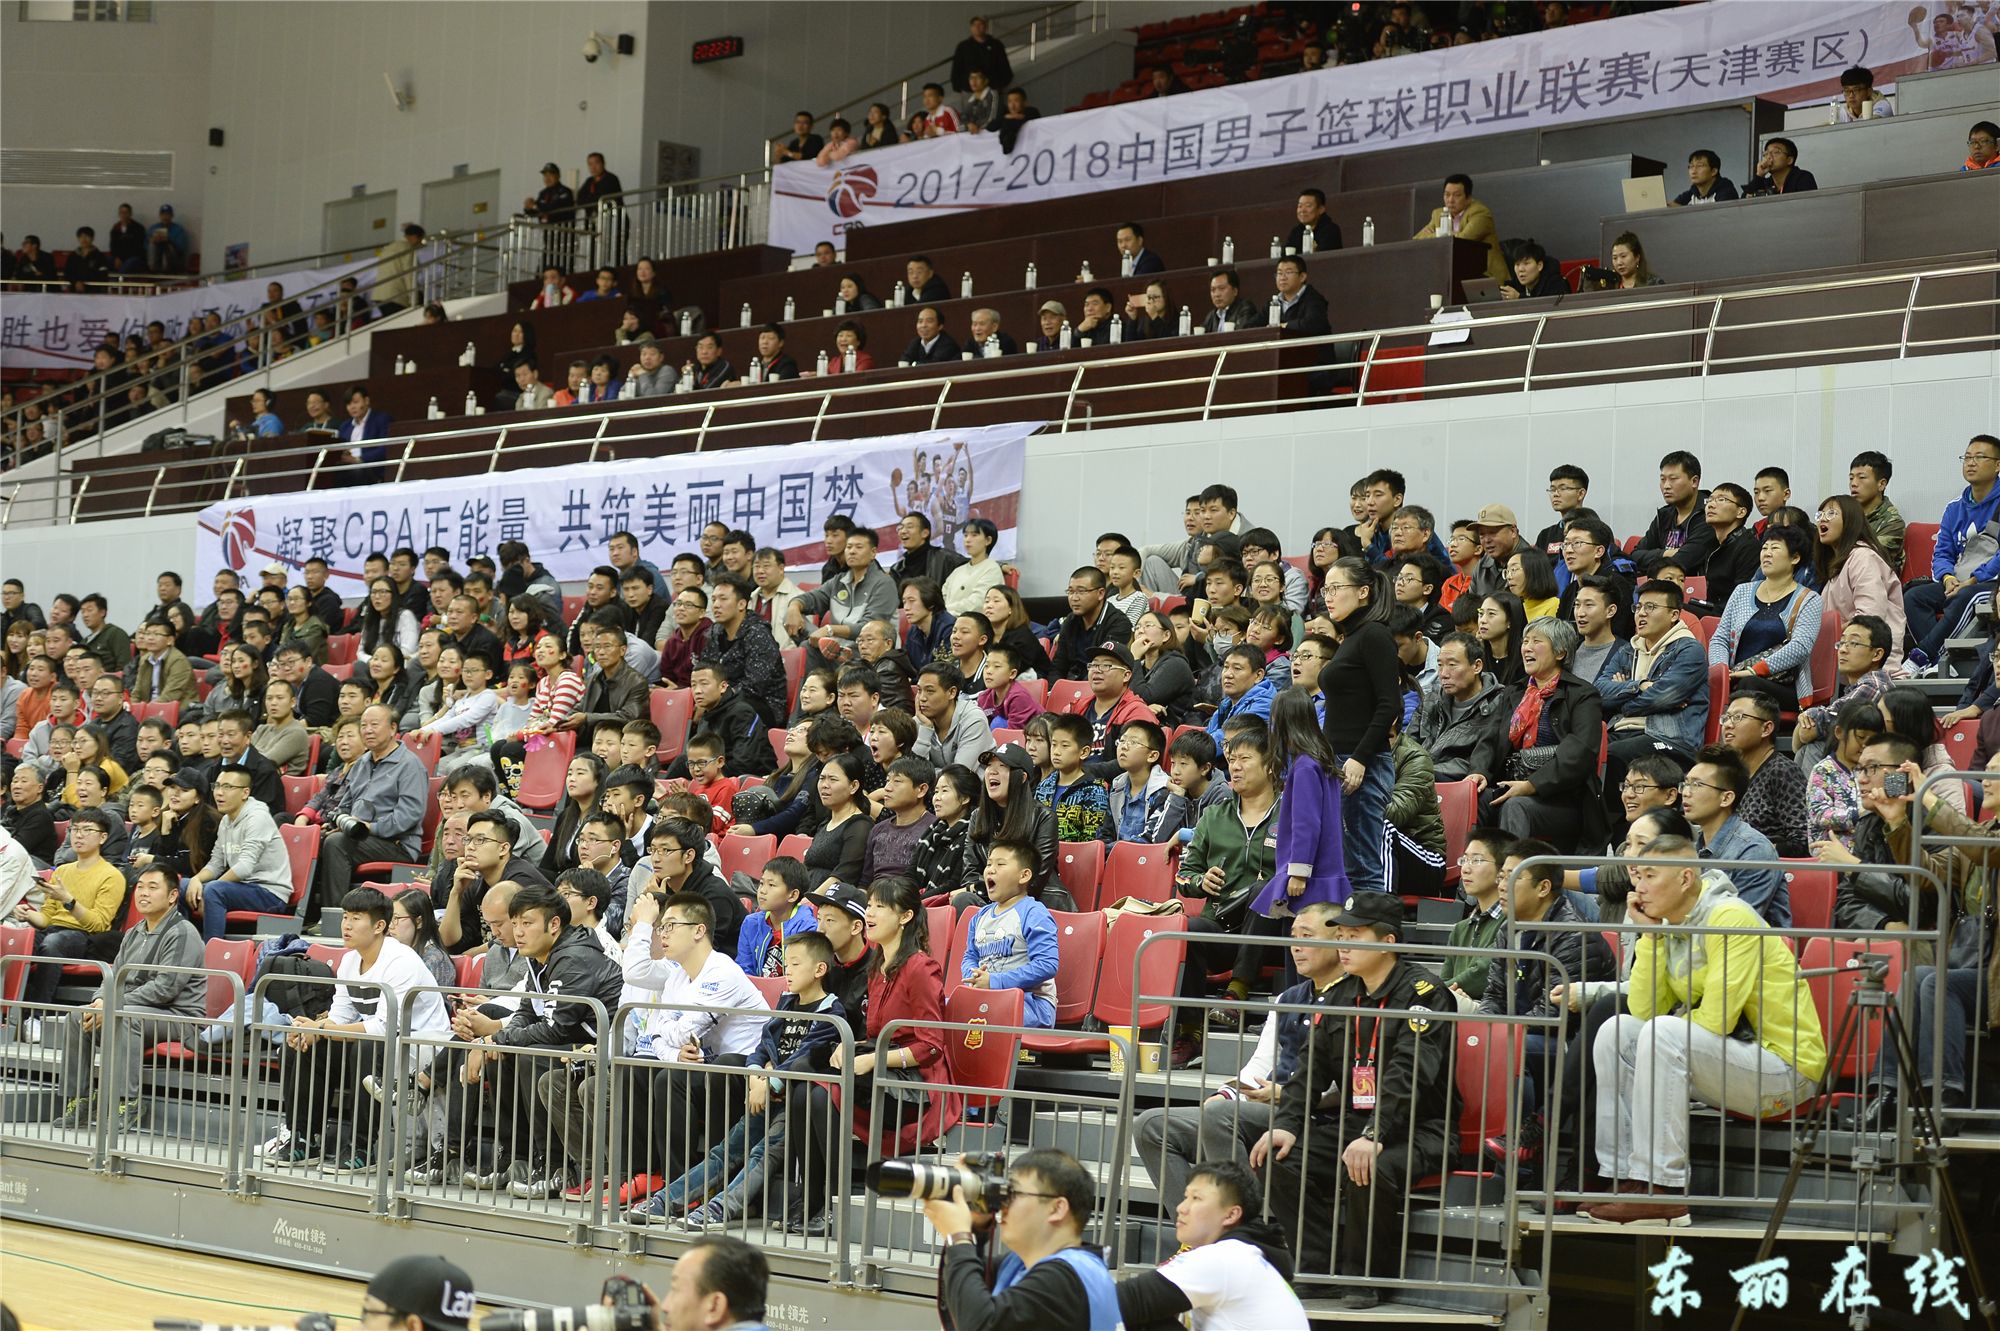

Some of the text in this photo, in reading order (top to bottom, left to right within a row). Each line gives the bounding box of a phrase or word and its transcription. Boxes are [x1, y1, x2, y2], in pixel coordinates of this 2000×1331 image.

[558, 464, 865, 553] 共筑美丽中国梦
